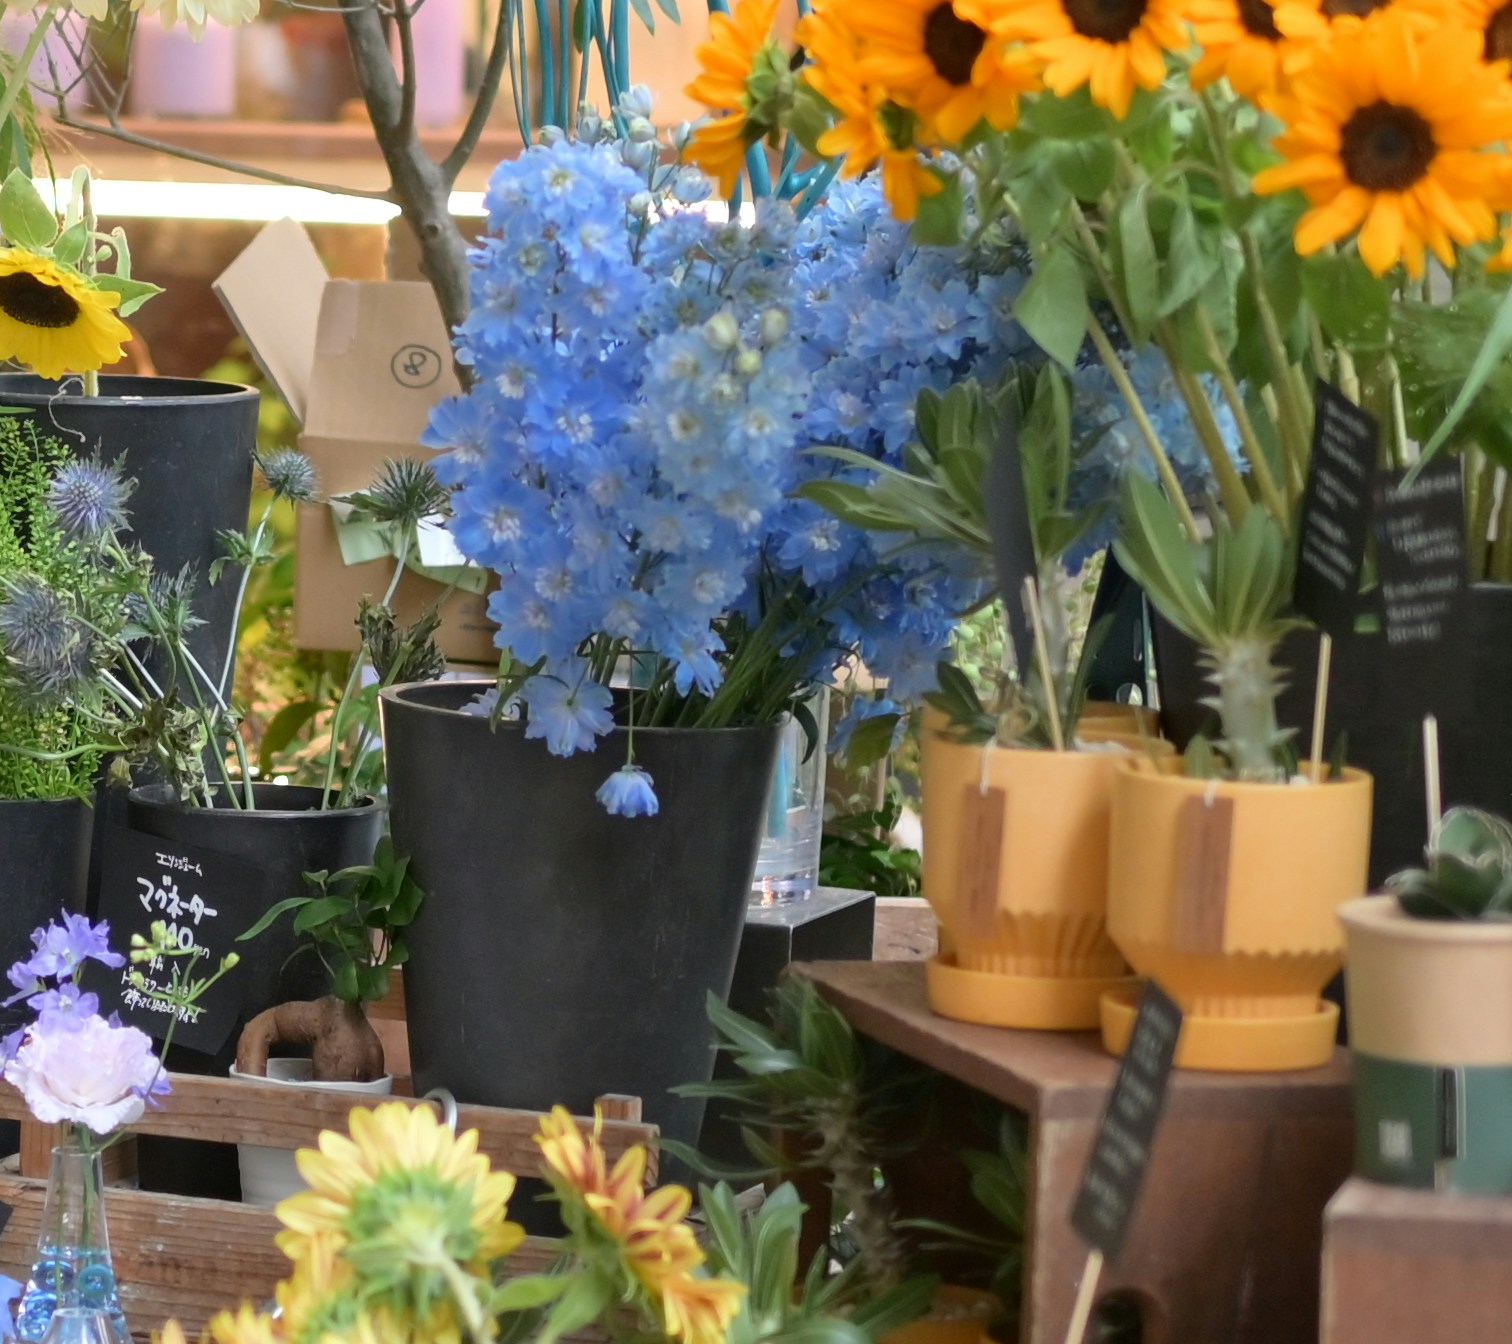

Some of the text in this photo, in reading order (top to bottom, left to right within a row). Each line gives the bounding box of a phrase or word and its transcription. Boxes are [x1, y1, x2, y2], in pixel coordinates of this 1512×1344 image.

[137, 874, 218, 926] マグネーター
